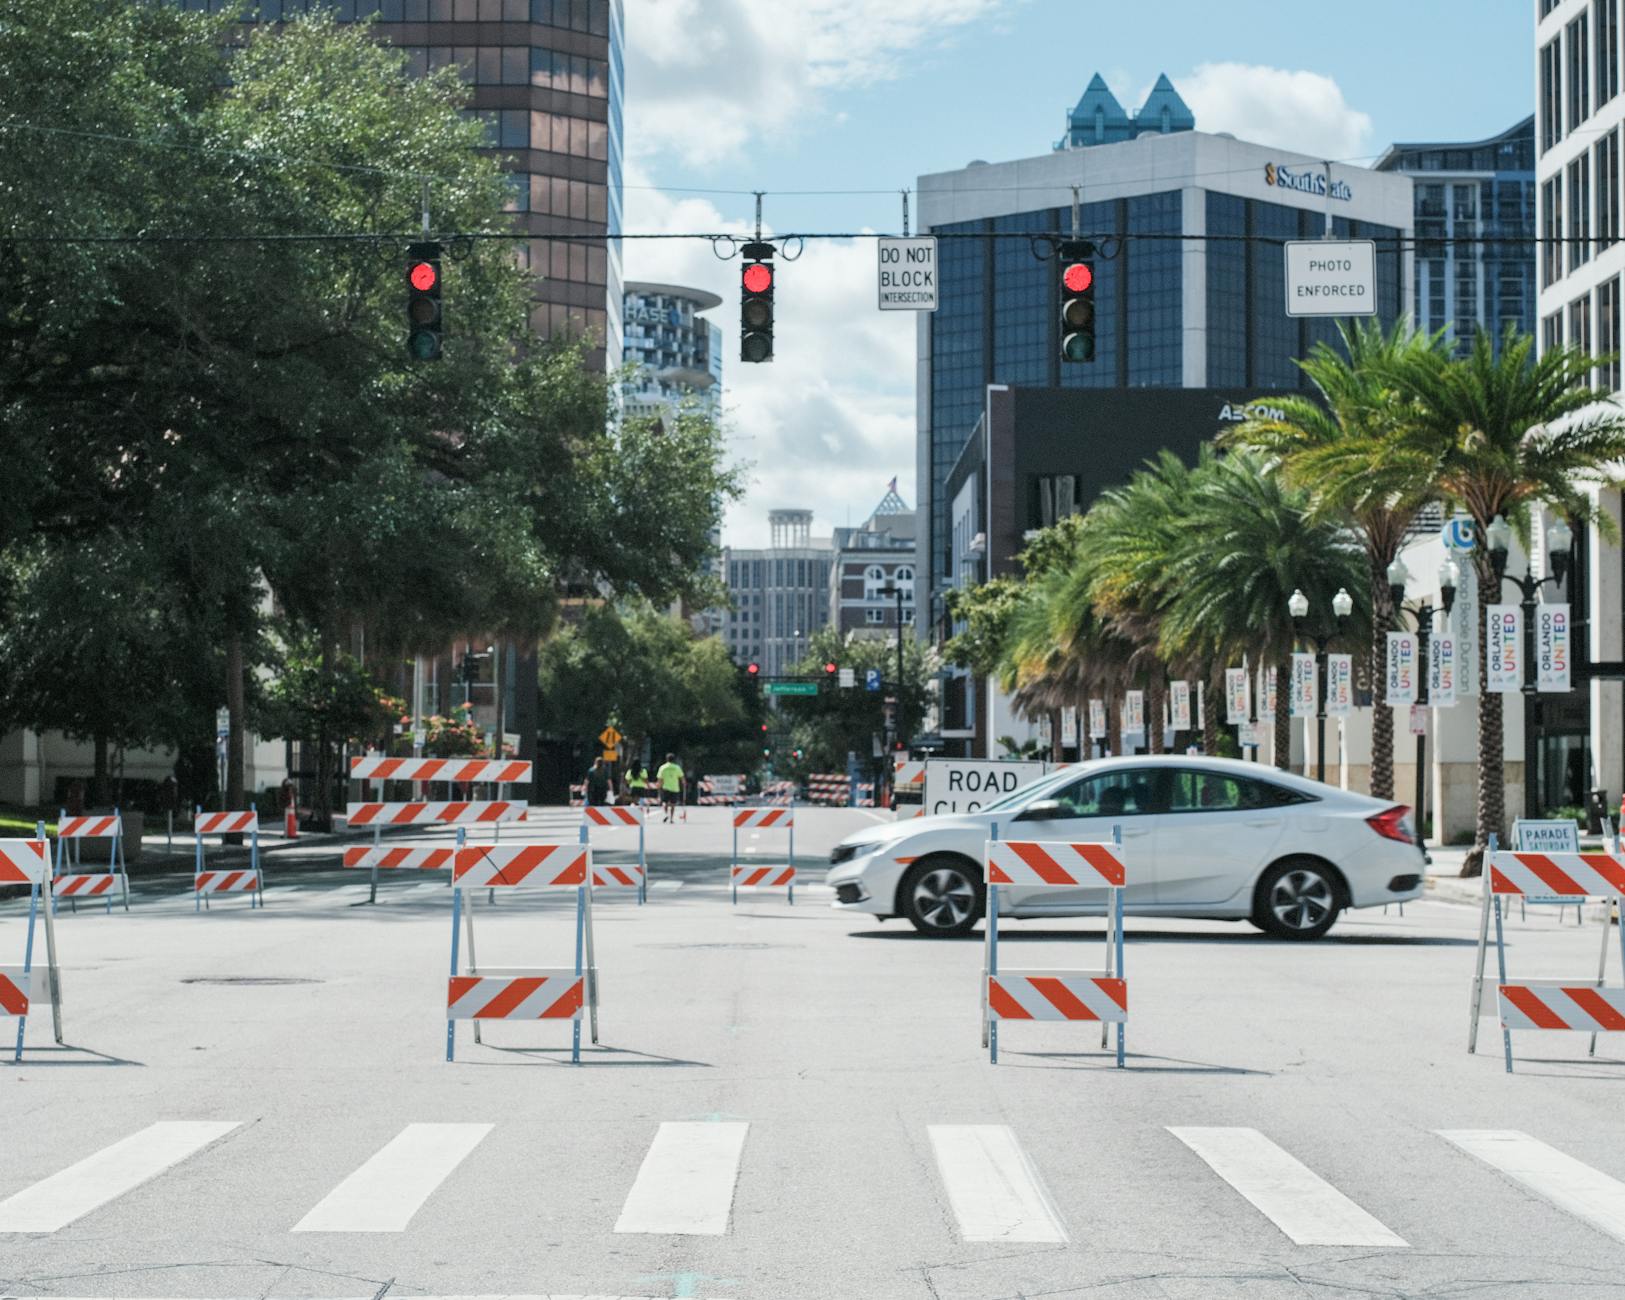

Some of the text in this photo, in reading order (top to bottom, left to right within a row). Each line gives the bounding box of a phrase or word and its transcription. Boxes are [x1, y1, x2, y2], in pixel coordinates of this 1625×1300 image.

[1276, 165, 1352, 201] SouthSate
[881, 247, 933, 263] DO NOT
[1309, 260, 1352, 272] PHOTO
[880, 291, 934, 303] INTERSECTION
[881, 271, 933, 287] BLOCK
[1297, 284, 1365, 297] ENFORCED
[624, 304, 669, 323] HASE
[1492, 613, 1501, 671] ORLANDO
[1504, 613, 1515, 671] UNITED
[1542, 613, 1551, 671] ORLANDO
[1554, 613, 1566, 671] UNITED
[1391, 639, 1399, 689] ORLANDO
[1401, 640, 1411, 689] UNITED
[1432, 640, 1440, 689] ORLANDO
[1442, 640, 1452, 689] UNITED
[1460, 642, 1473, 692] Duncan
[949, 770, 1018, 793] ROAD
[1526, 829, 1569, 840] PARADE
[1529, 842, 1569, 851] SATURDAY
